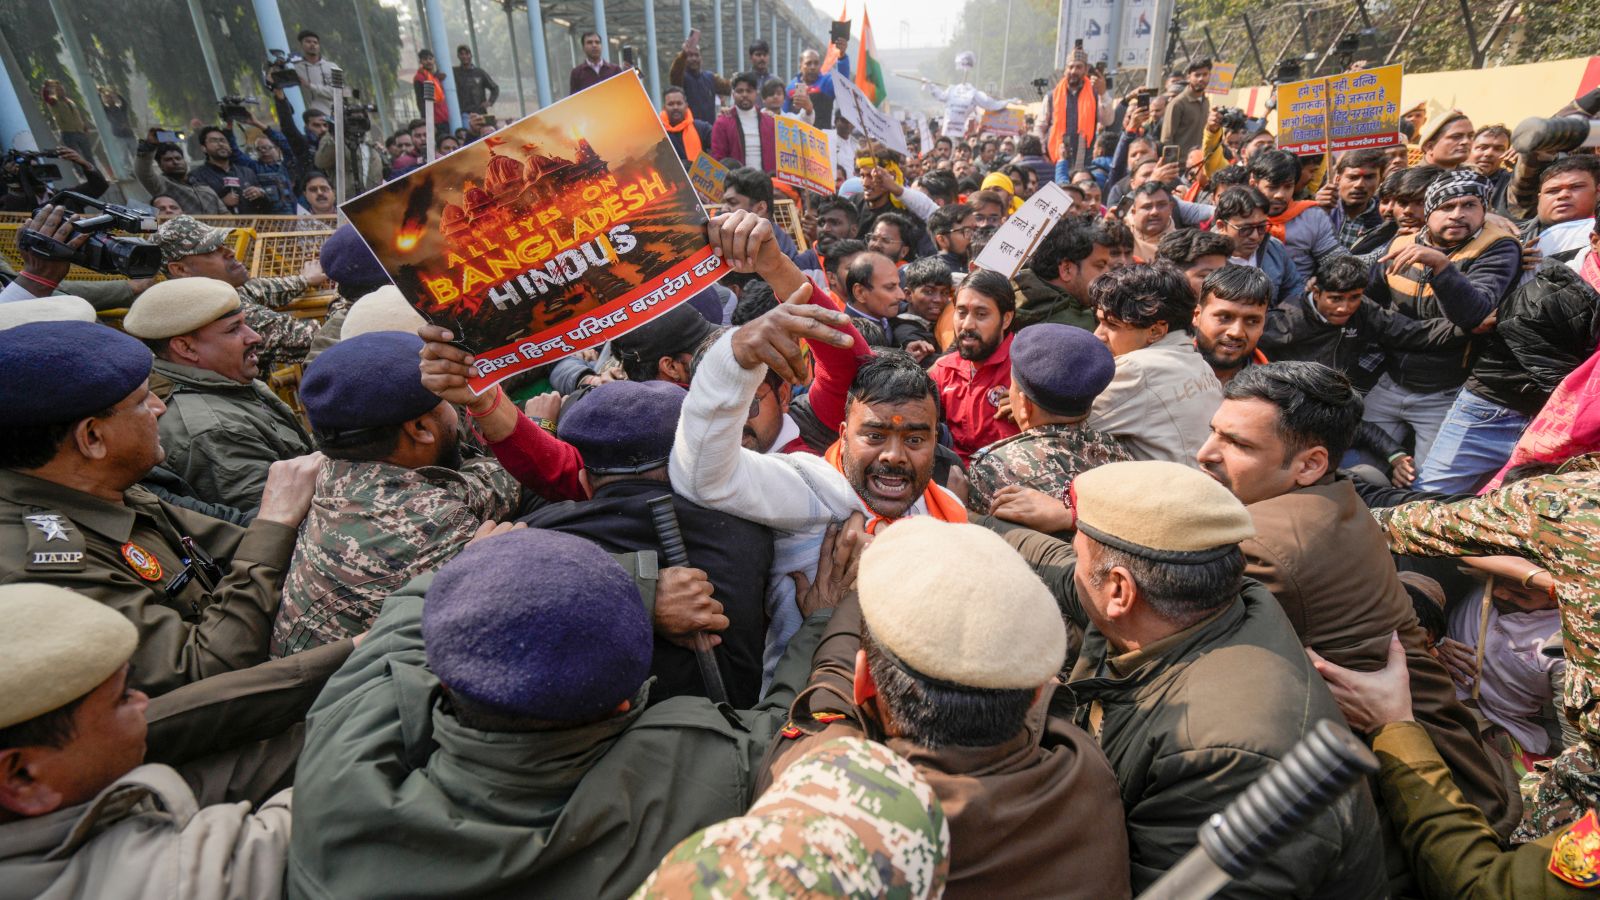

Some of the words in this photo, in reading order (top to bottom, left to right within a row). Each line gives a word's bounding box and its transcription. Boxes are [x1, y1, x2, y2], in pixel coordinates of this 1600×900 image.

[1302, 113, 1327, 125] मिलक
[429, 172, 668, 306] BANGLADESH
[448, 236, 499, 269] ALL
[504, 205, 562, 241] EYES
[582, 175, 618, 201] ON
[488, 223, 637, 311] HINDUS
[472, 350, 520, 378] विश्व
[518, 335, 576, 361] हिन्दू
[567, 307, 629, 342] परिषद
[629, 274, 692, 315] बजरंग
[693, 254, 721, 279] दल
[33, 552, 84, 564] DANP
